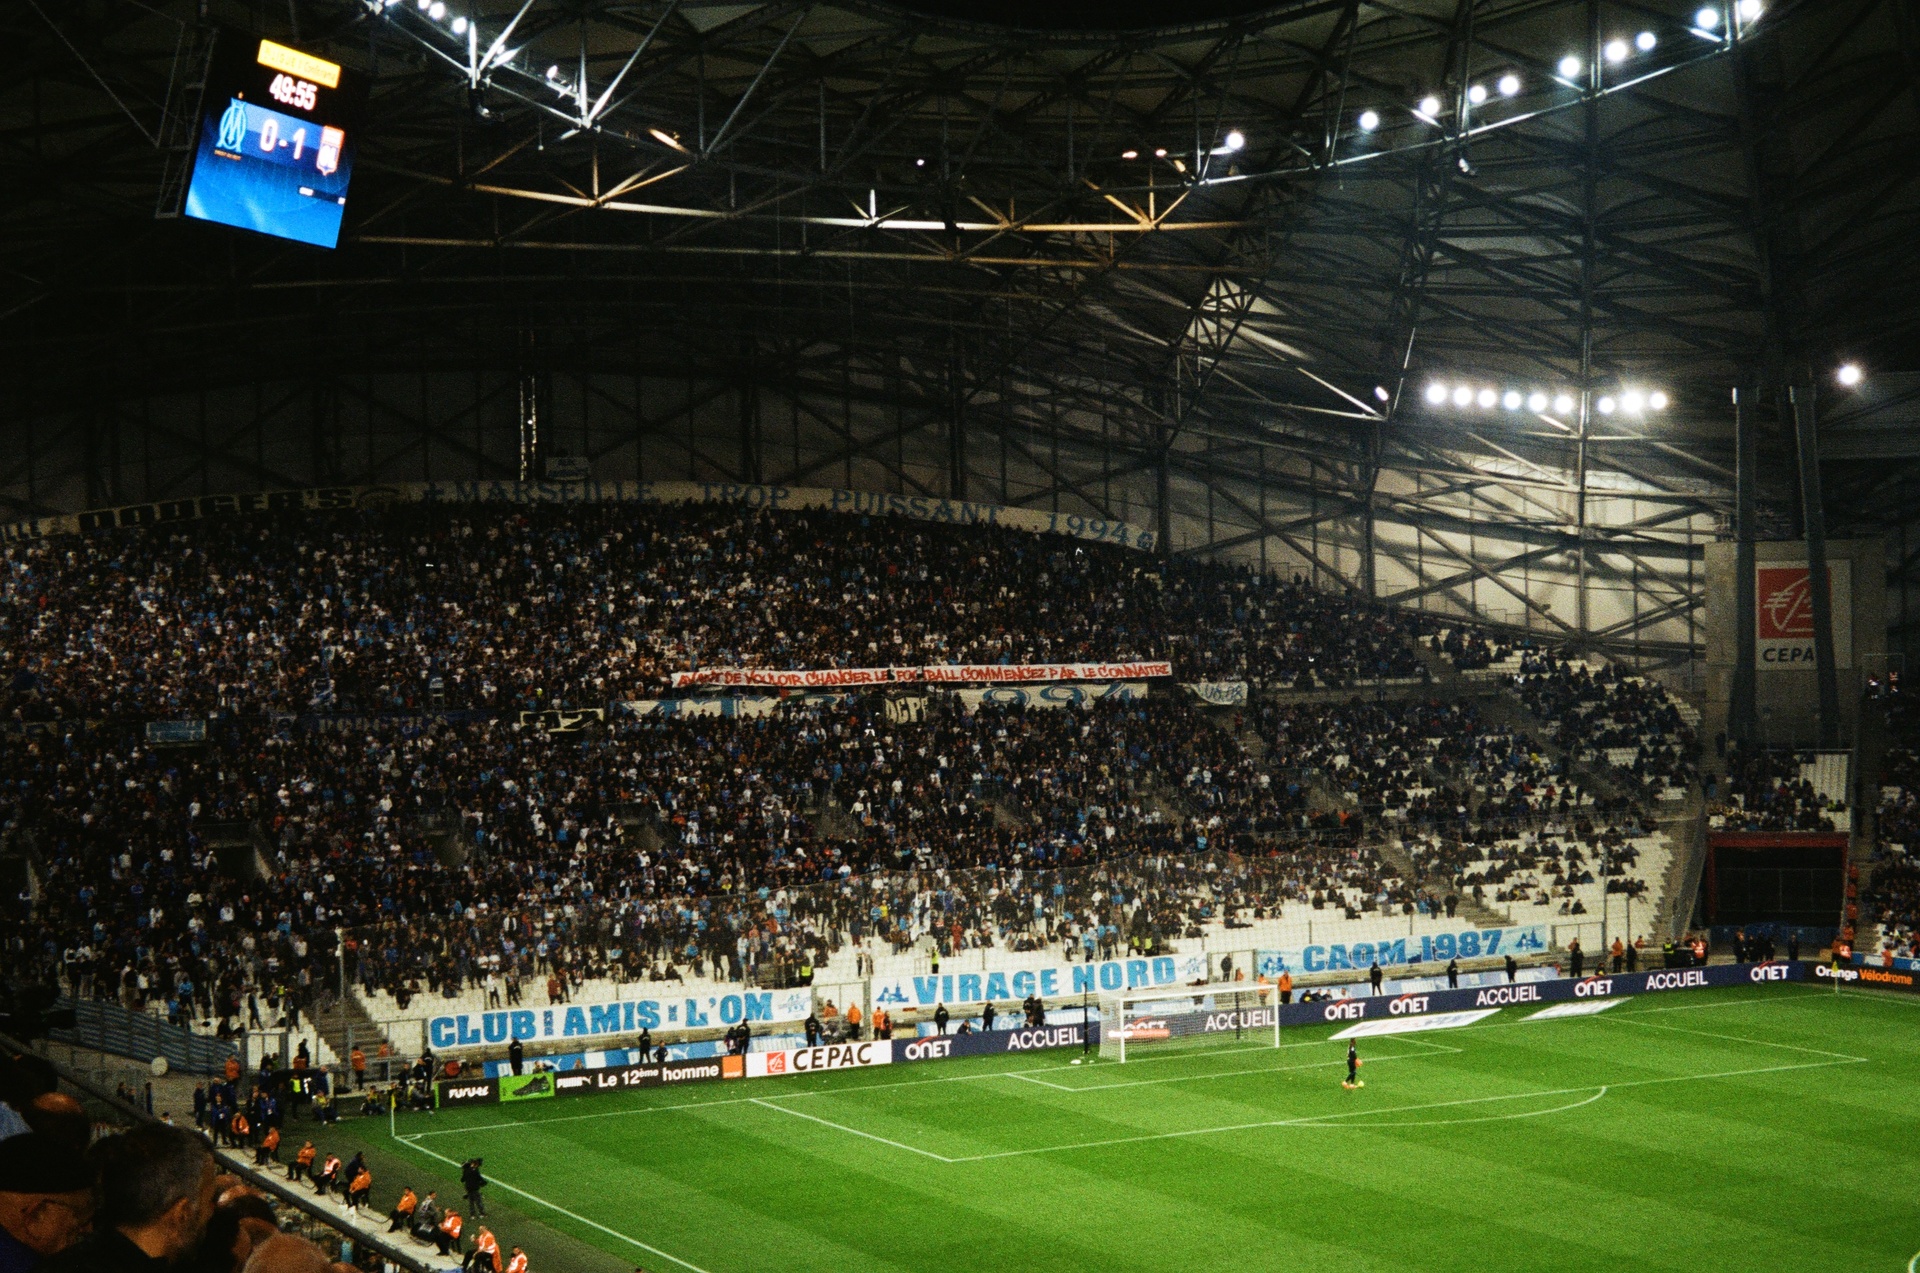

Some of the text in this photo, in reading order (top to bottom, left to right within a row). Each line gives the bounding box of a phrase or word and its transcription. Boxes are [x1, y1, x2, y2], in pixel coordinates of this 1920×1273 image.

[269, 74, 317, 110] 49:55
[702, 482, 790, 508] TROP
[832, 488, 1006, 524] PUISSANT
[1046, 512, 1128, 544] 1994
[1762, 647, 1815, 663] CEPA
[678, 670, 723, 686] AVANT
[724, 671, 741, 684] DE
[745, 670, 804, 686] VOULOIR
[805, 669, 873, 686] CHANGER
[874, 669, 888, 682] LE
[961, 665, 1046, 681] COMMENCEZ
[1082, 667, 1097, 678] LE
[1303, 929, 1504, 973] CAOM 1987
[912, 956, 1176, 1004] VIRAGE NORD
[1646, 970, 1708, 990] ACCUEIL
[1859, 968, 1913, 985] Vélodrome
[1476, 985, 1541, 1007] ACCUEIL
[430, 1010, 535, 1048] CLUB
[563, 1000, 660, 1037] AMIS
[685, 992, 774, 1027] L'OM
[1204, 1010, 1276, 1032] ACCUEIL
[1007, 1026, 1084, 1050] ACCUEIL
[793, 1043, 872, 1071] CEPAC
[598, 1073, 617, 1088] Le
[662, 1065, 719, 1082] homme
